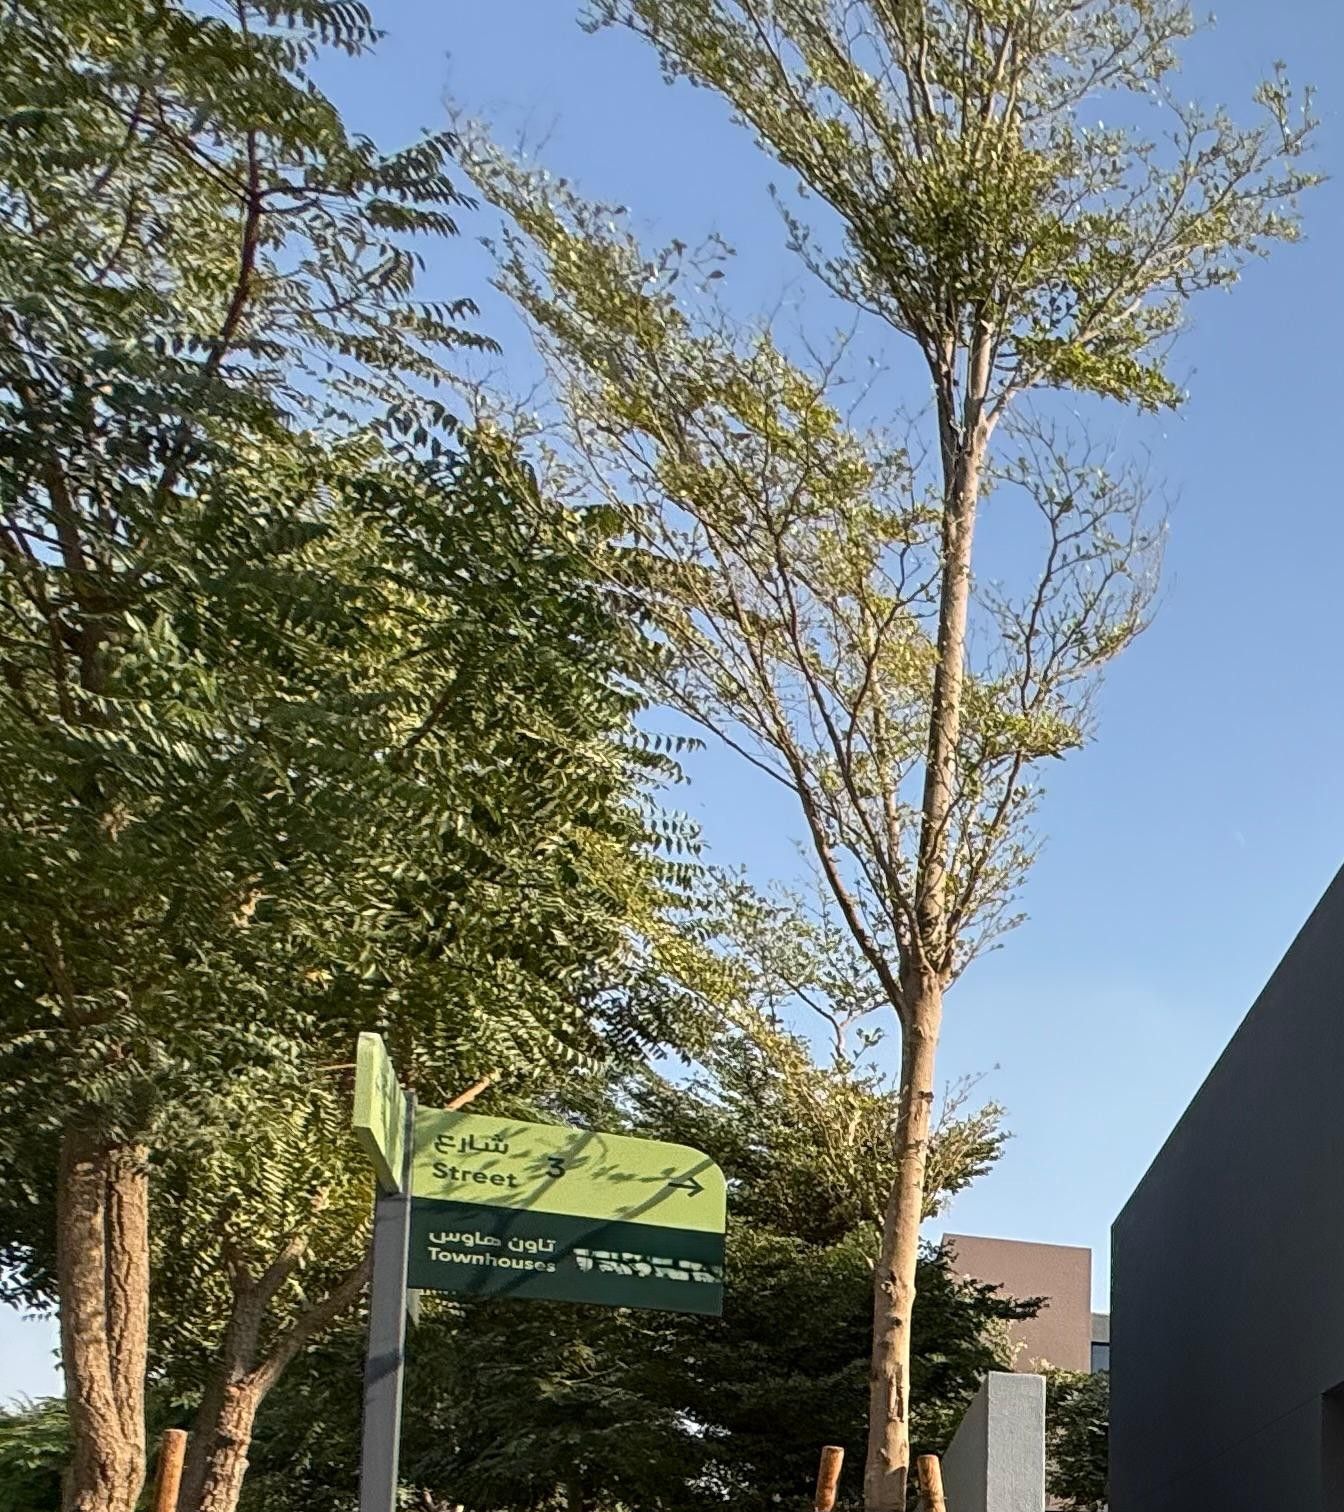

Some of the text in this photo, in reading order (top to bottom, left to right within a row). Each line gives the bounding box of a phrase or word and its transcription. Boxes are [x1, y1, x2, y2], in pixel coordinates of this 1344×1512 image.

[434, 1133, 509, 1155] شارع
[432, 1161, 519, 1188] Street
[545, 1156, 566, 1179] 3
[429, 1231, 557, 1254] تاون هاوس
[427, 1246, 557, 1273] Townhouses
